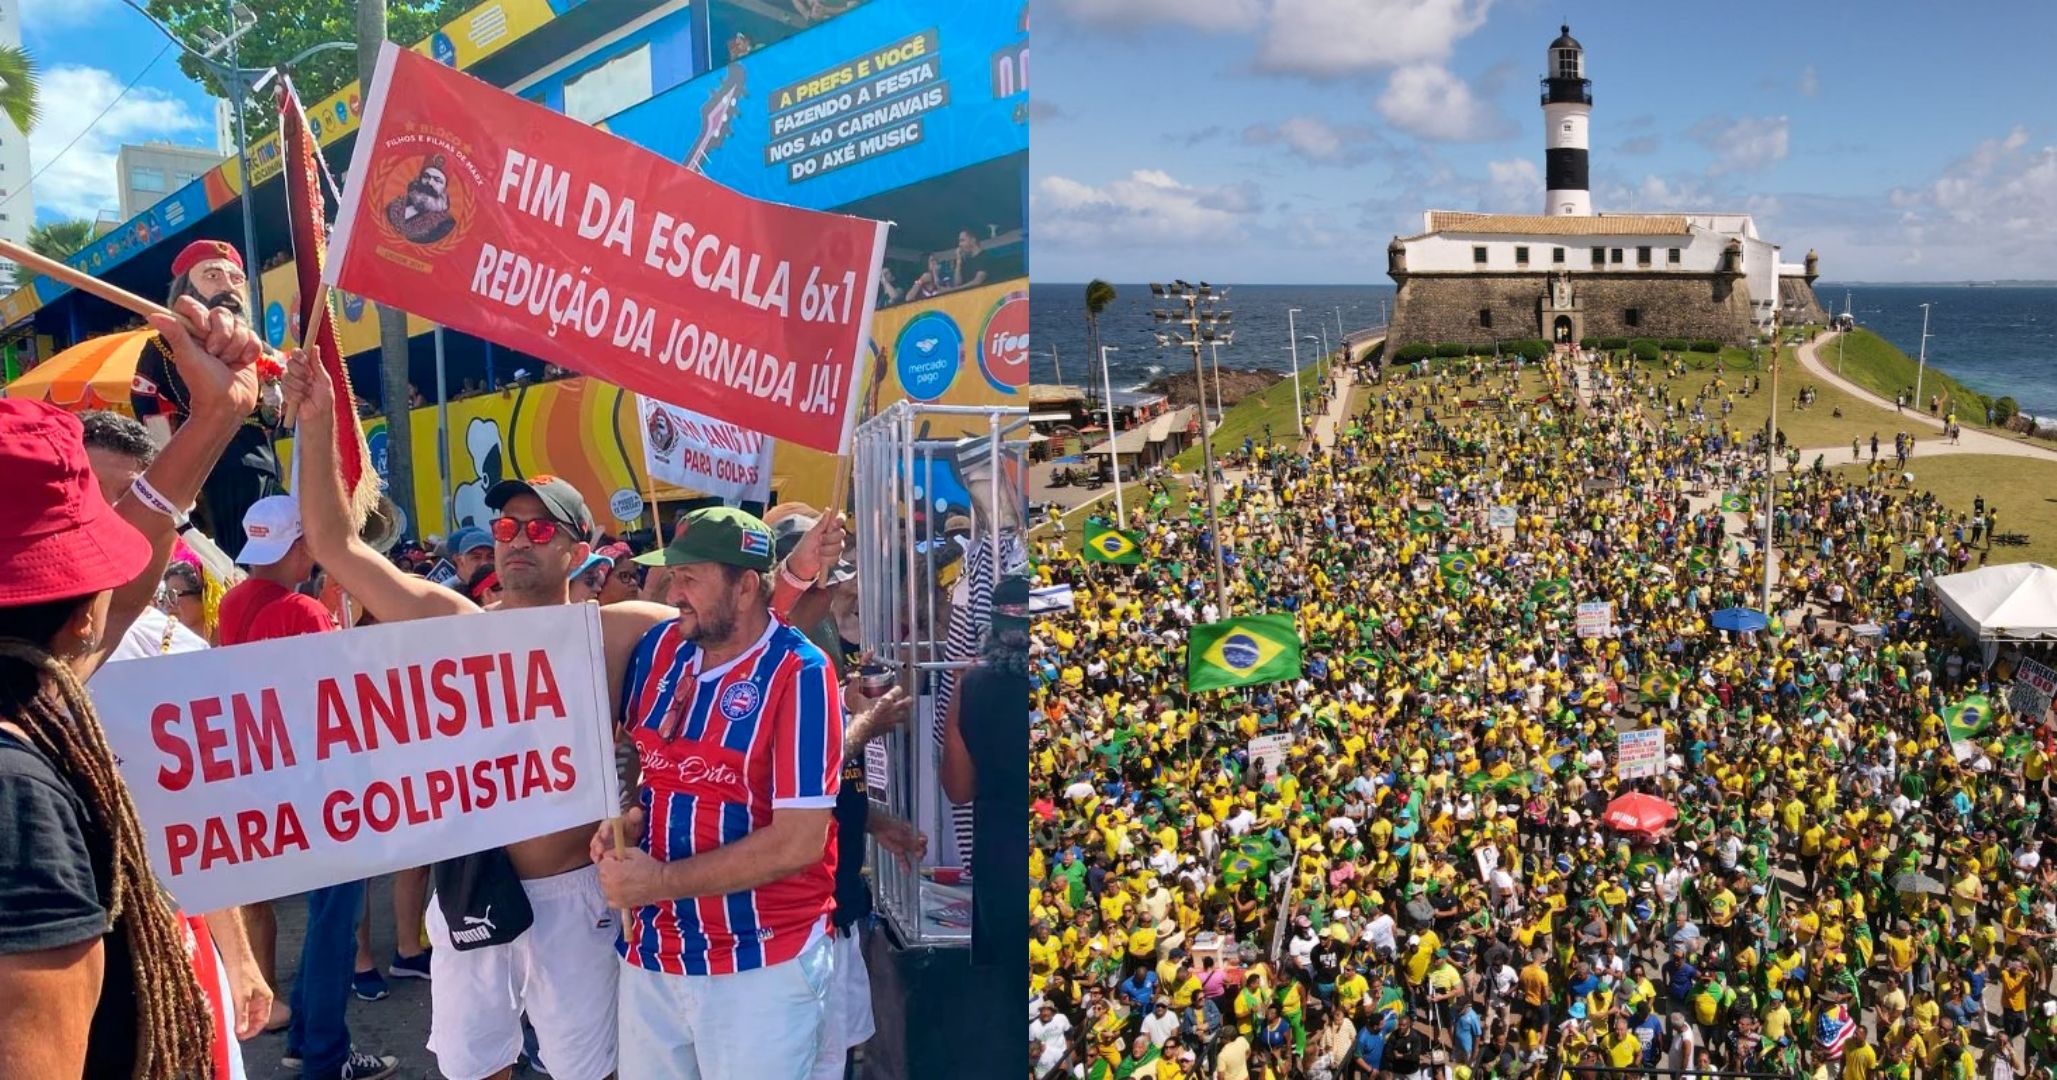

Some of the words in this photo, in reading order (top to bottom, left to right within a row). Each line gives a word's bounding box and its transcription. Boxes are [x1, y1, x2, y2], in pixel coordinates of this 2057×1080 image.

[774, 93, 852, 135] FAZENDO
[857, 87, 871, 105] A
[876, 63, 933, 98] FESTA
[780, 92, 792, 108] A
[796, 67, 853, 102] PREFS
[857, 60, 870, 78] E
[874, 35, 926, 71] VOCÊ
[385, 134, 416, 149] FILHOS
[418, 134, 424, 142] E
[426, 135, 455, 153] FILHAS
[456, 150, 467, 163] DE
[465, 160, 485, 187] MARX
[770, 137, 805, 162] NOS
[810, 129, 833, 147] 40
[837, 88, 943, 138] CARNAVAIS
[792, 161, 817, 180] DO
[822, 144, 856, 170] AXÉ
[860, 123, 919, 157] MUSIC
[497, 148, 571, 228] FIM
[577, 182, 635, 257] DA
[644, 211, 791, 318] ESCALA
[800, 266, 857, 325] 6x1
[471, 243, 610, 338] REDUÇÃO
[612, 298, 657, 358] DA
[658, 318, 797, 407] JORNADA
[799, 348, 843, 416] JÁ!
[908, 358, 947, 374] mercado
[916, 372, 939, 386] pago
[684, 447, 713, 477] PARA
[150, 687, 297, 792] SEM
[316, 649, 568, 761] ANISTIA
[164, 802, 311, 877] PARA
[322, 745, 577, 843] GOLPISTAS
[451, 925, 492, 944] PUMA
